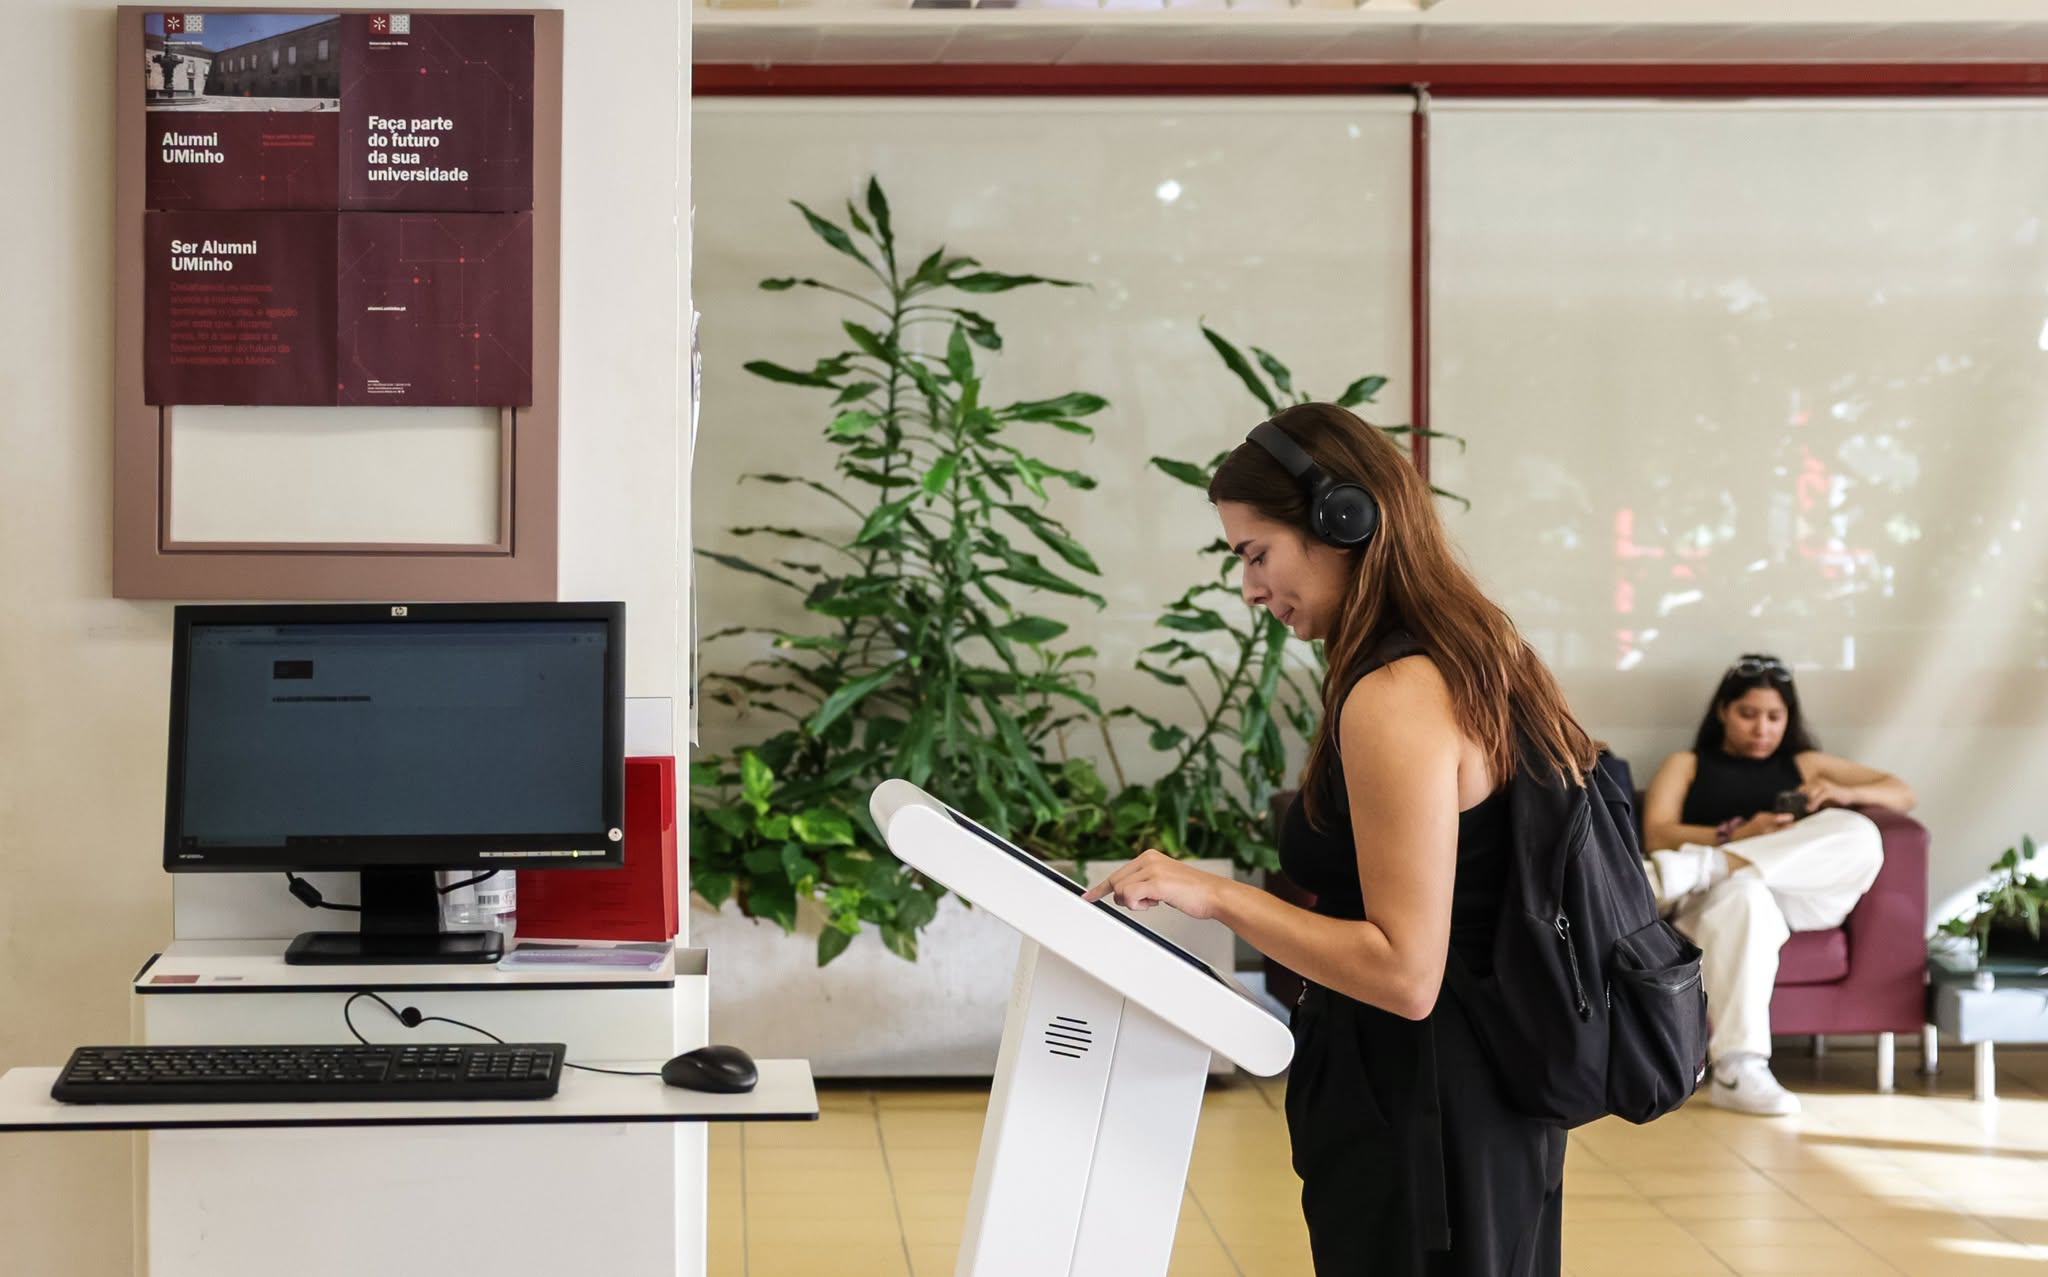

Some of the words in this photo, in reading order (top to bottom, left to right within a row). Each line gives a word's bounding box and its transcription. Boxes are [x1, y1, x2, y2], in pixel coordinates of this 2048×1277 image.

[368, 116, 406, 133] Faça
[411, 117, 453, 133] parte
[162, 132, 218, 147] Alumni
[368, 133, 388, 147] do
[391, 133, 440, 147] futuro
[162, 149, 225, 164] UMinho
[368, 150, 388, 164] da
[391, 153, 420, 164] sua
[368, 167, 469, 182] universidade
[171, 240, 198, 254] Ser
[202, 240, 257, 255] Alumni
[171, 257, 233, 271] UMinho
